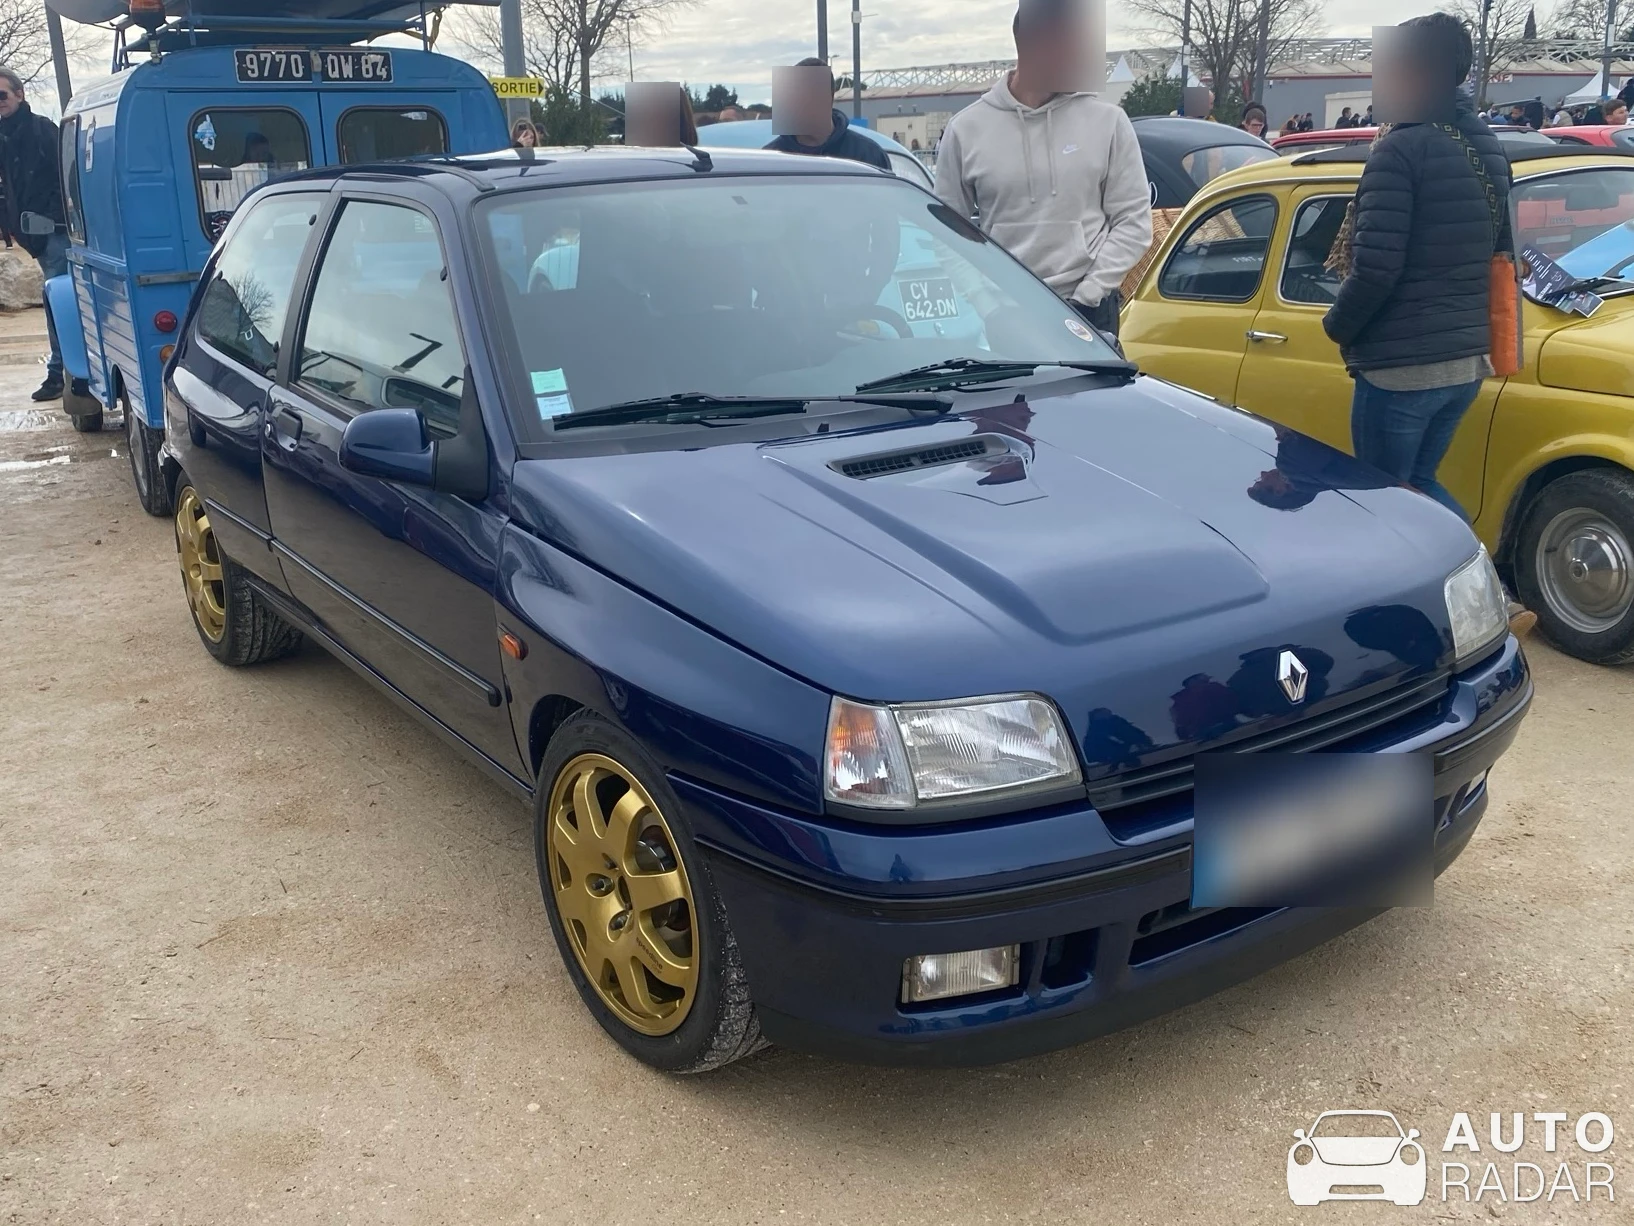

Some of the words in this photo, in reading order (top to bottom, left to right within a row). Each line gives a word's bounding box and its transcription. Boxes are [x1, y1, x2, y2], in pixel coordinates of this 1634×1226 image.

[245, 53, 304, 78] 9770
[361, 54, 388, 80] 84
[492, 82, 537, 93] SORTIE
[910, 282, 928, 300] CV
